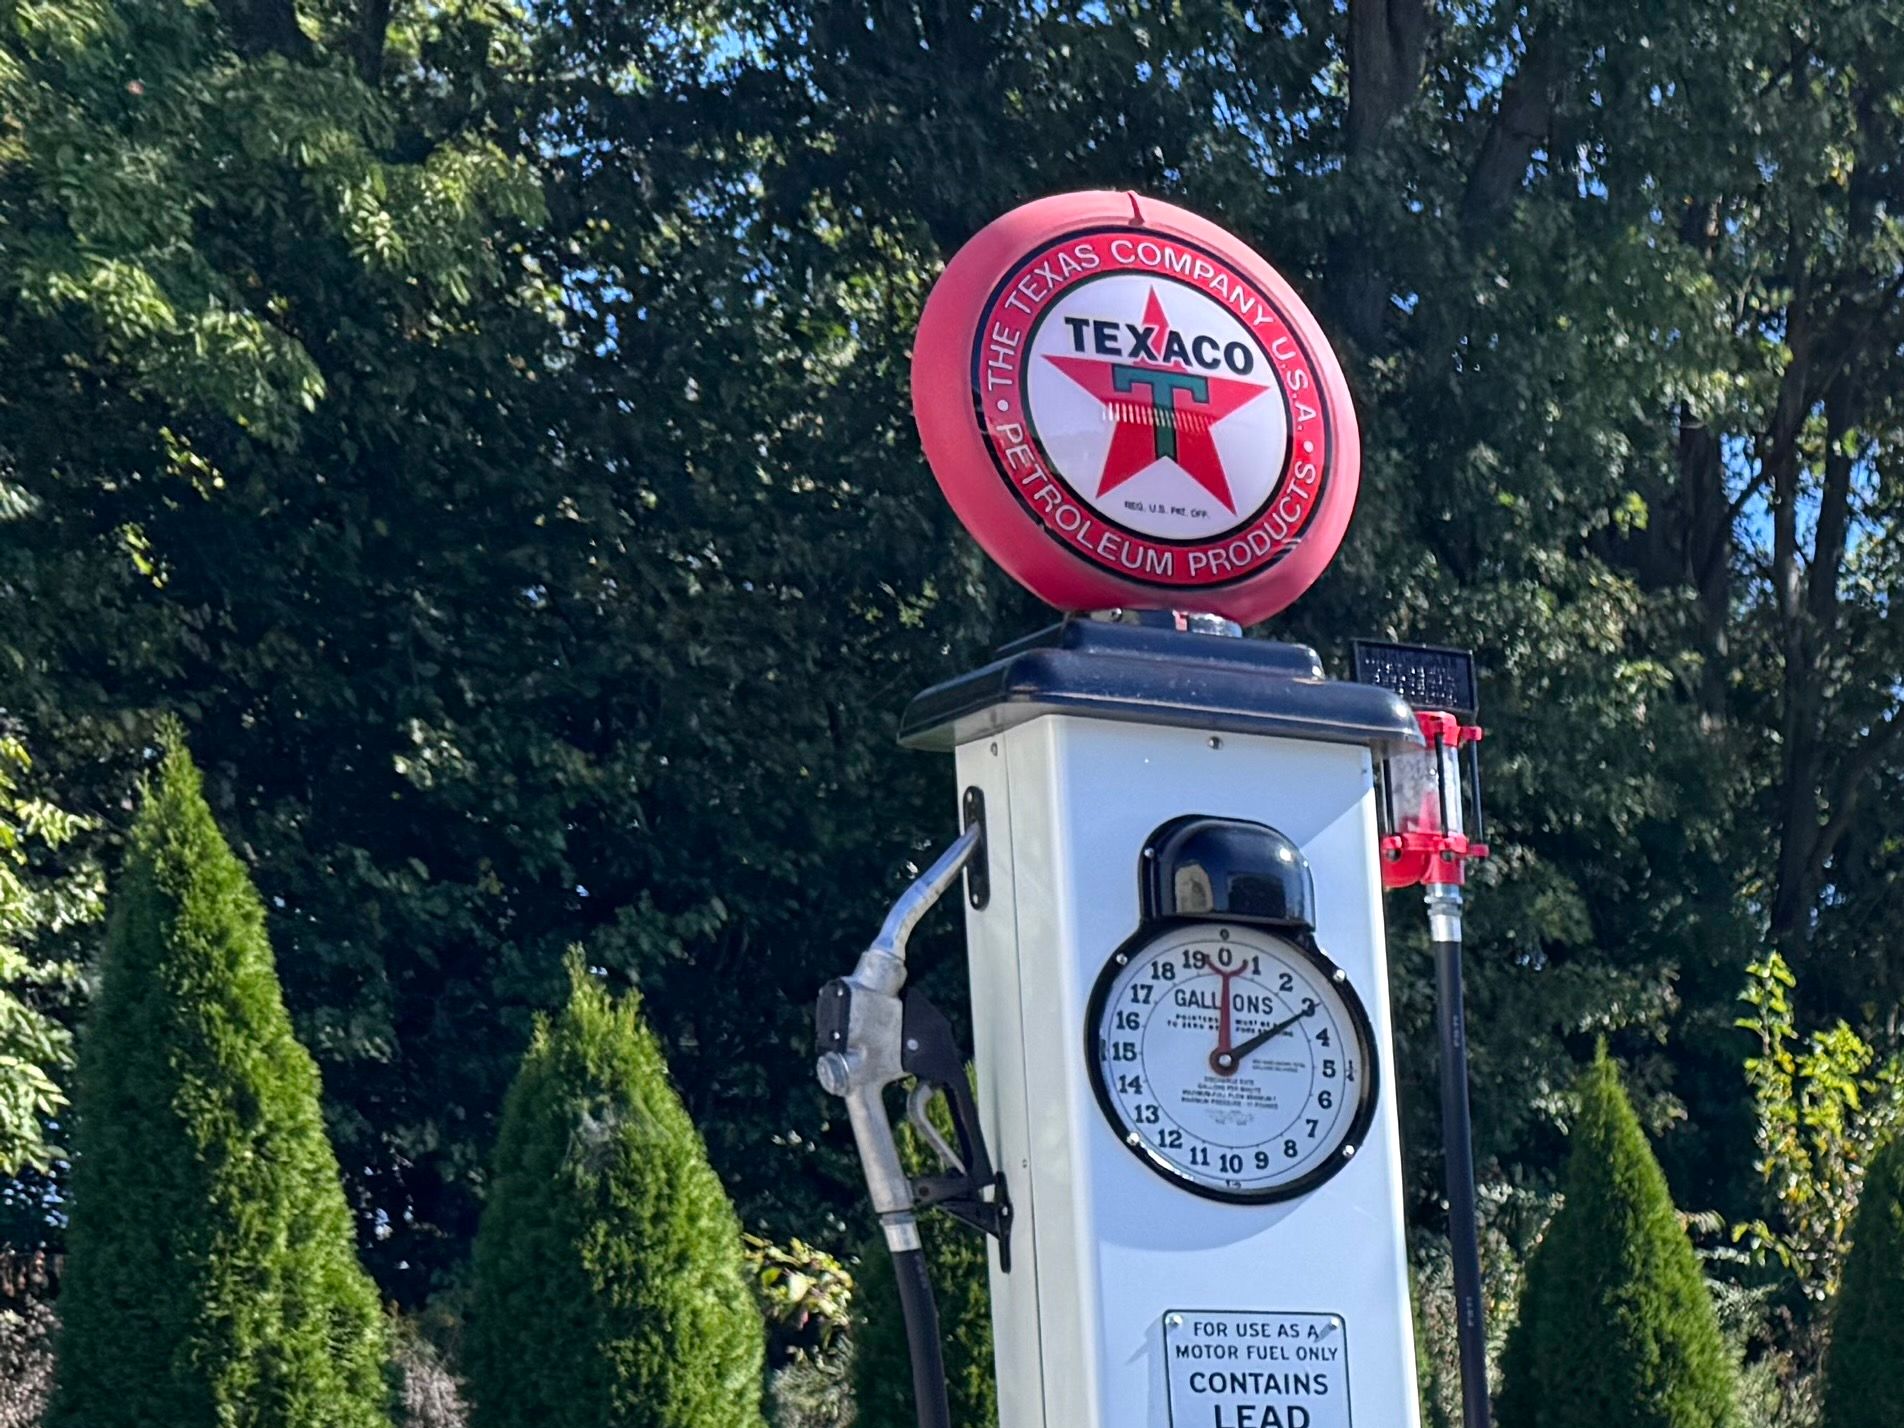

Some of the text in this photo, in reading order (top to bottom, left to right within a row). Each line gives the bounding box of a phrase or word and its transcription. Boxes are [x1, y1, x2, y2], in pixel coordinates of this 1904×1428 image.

[988, 240, 1315, 431] THE TEXAS COMPANY U.S.A.
[1064, 316, 1254, 375] TEXACO
[997, 423, 1317, 577] PETROLEUM PRODUCTS
[1183, 950, 1206, 969] 19
[1218, 947, 1232, 967] 0
[1251, 955, 1261, 975] 1
[1151, 961, 1175, 981] 18
[1279, 973, 1294, 991] 2
[1130, 984, 1153, 1004] 17
[1174, 989, 1273, 1014] GALLONS
[1116, 1011, 1140, 1030] 16
[1316, 1028, 1330, 1047] 4
[1113, 1042, 1136, 1061] 15
[1323, 1059, 1336, 1078] 5
[1119, 1076, 1143, 1095] 14
[1318, 1091, 1332, 1109] 6
[1135, 1105, 1160, 1124] 13
[1305, 1119, 1319, 1138] 7
[1158, 1129, 1183, 1150] 12
[1283, 1140, 1298, 1158] 8
[1190, 1147, 1210, 1166] 11
[1220, 1154, 1242, 1173] 10
[1255, 1151, 1269, 1169] 9
[1194, 1322, 1319, 1341] FOR USE AS A
[1176, 1346, 1338, 1362] MOTOR FUEL ONLY
[1189, 1372, 1328, 1395] CONTAINS
